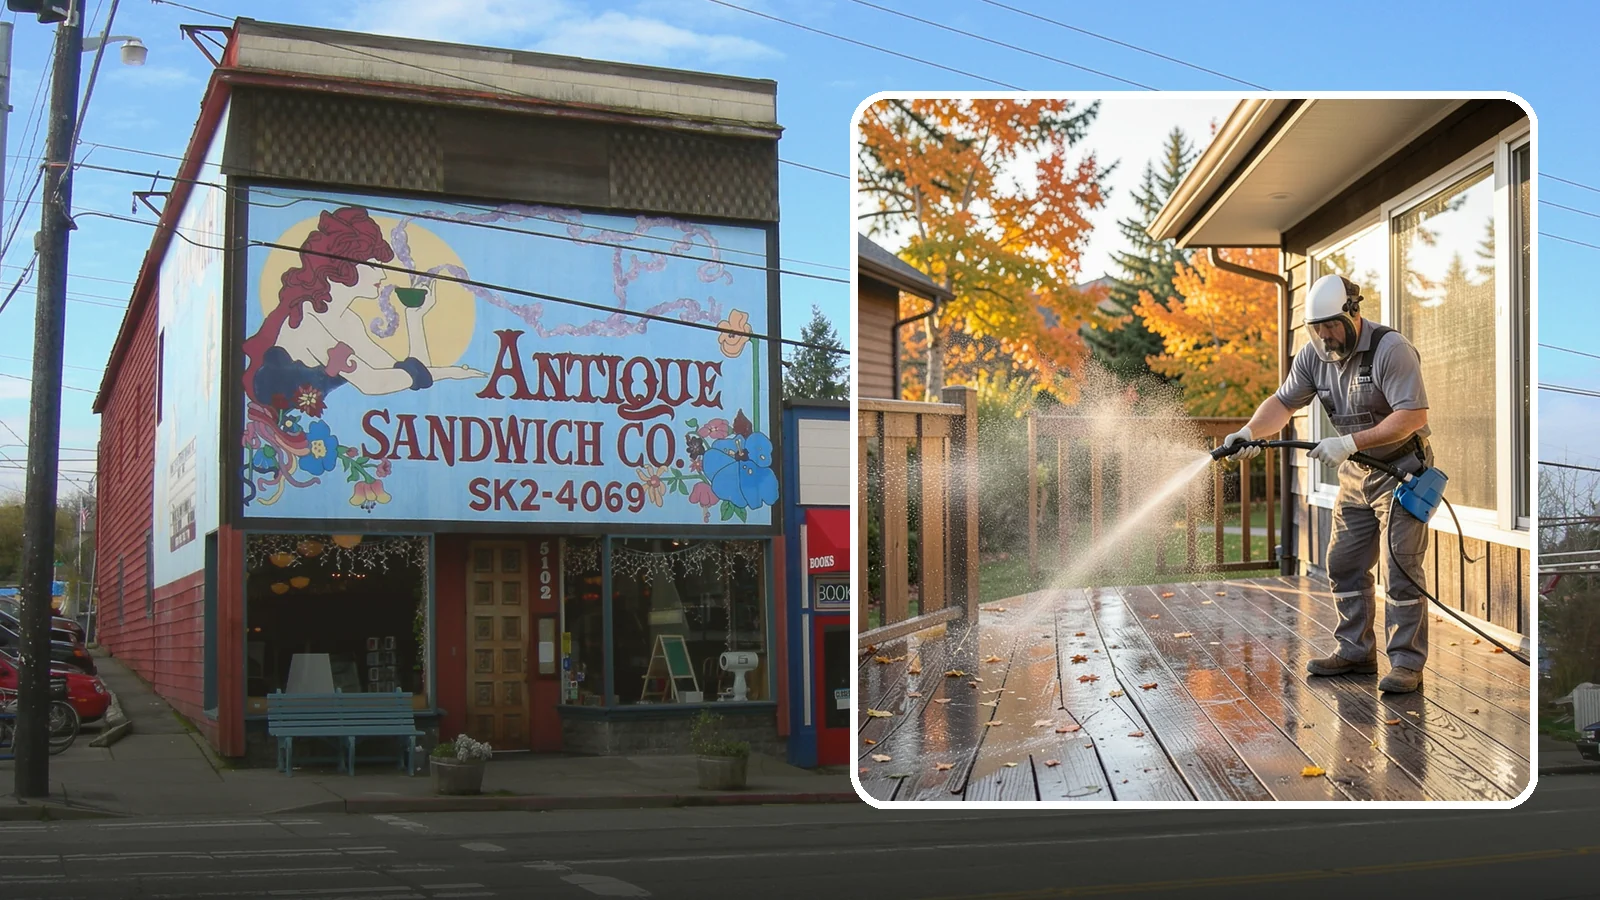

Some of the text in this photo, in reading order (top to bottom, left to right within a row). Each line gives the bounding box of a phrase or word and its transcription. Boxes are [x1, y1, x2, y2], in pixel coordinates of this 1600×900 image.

[475, 328, 723, 421] ANTIQUE
[361, 408, 685, 468] SANDWICH CO.
[468, 477, 646, 512] SK2-4069
[539, 541, 552, 600] 5102
[809, 554, 835, 569] BOOKS
